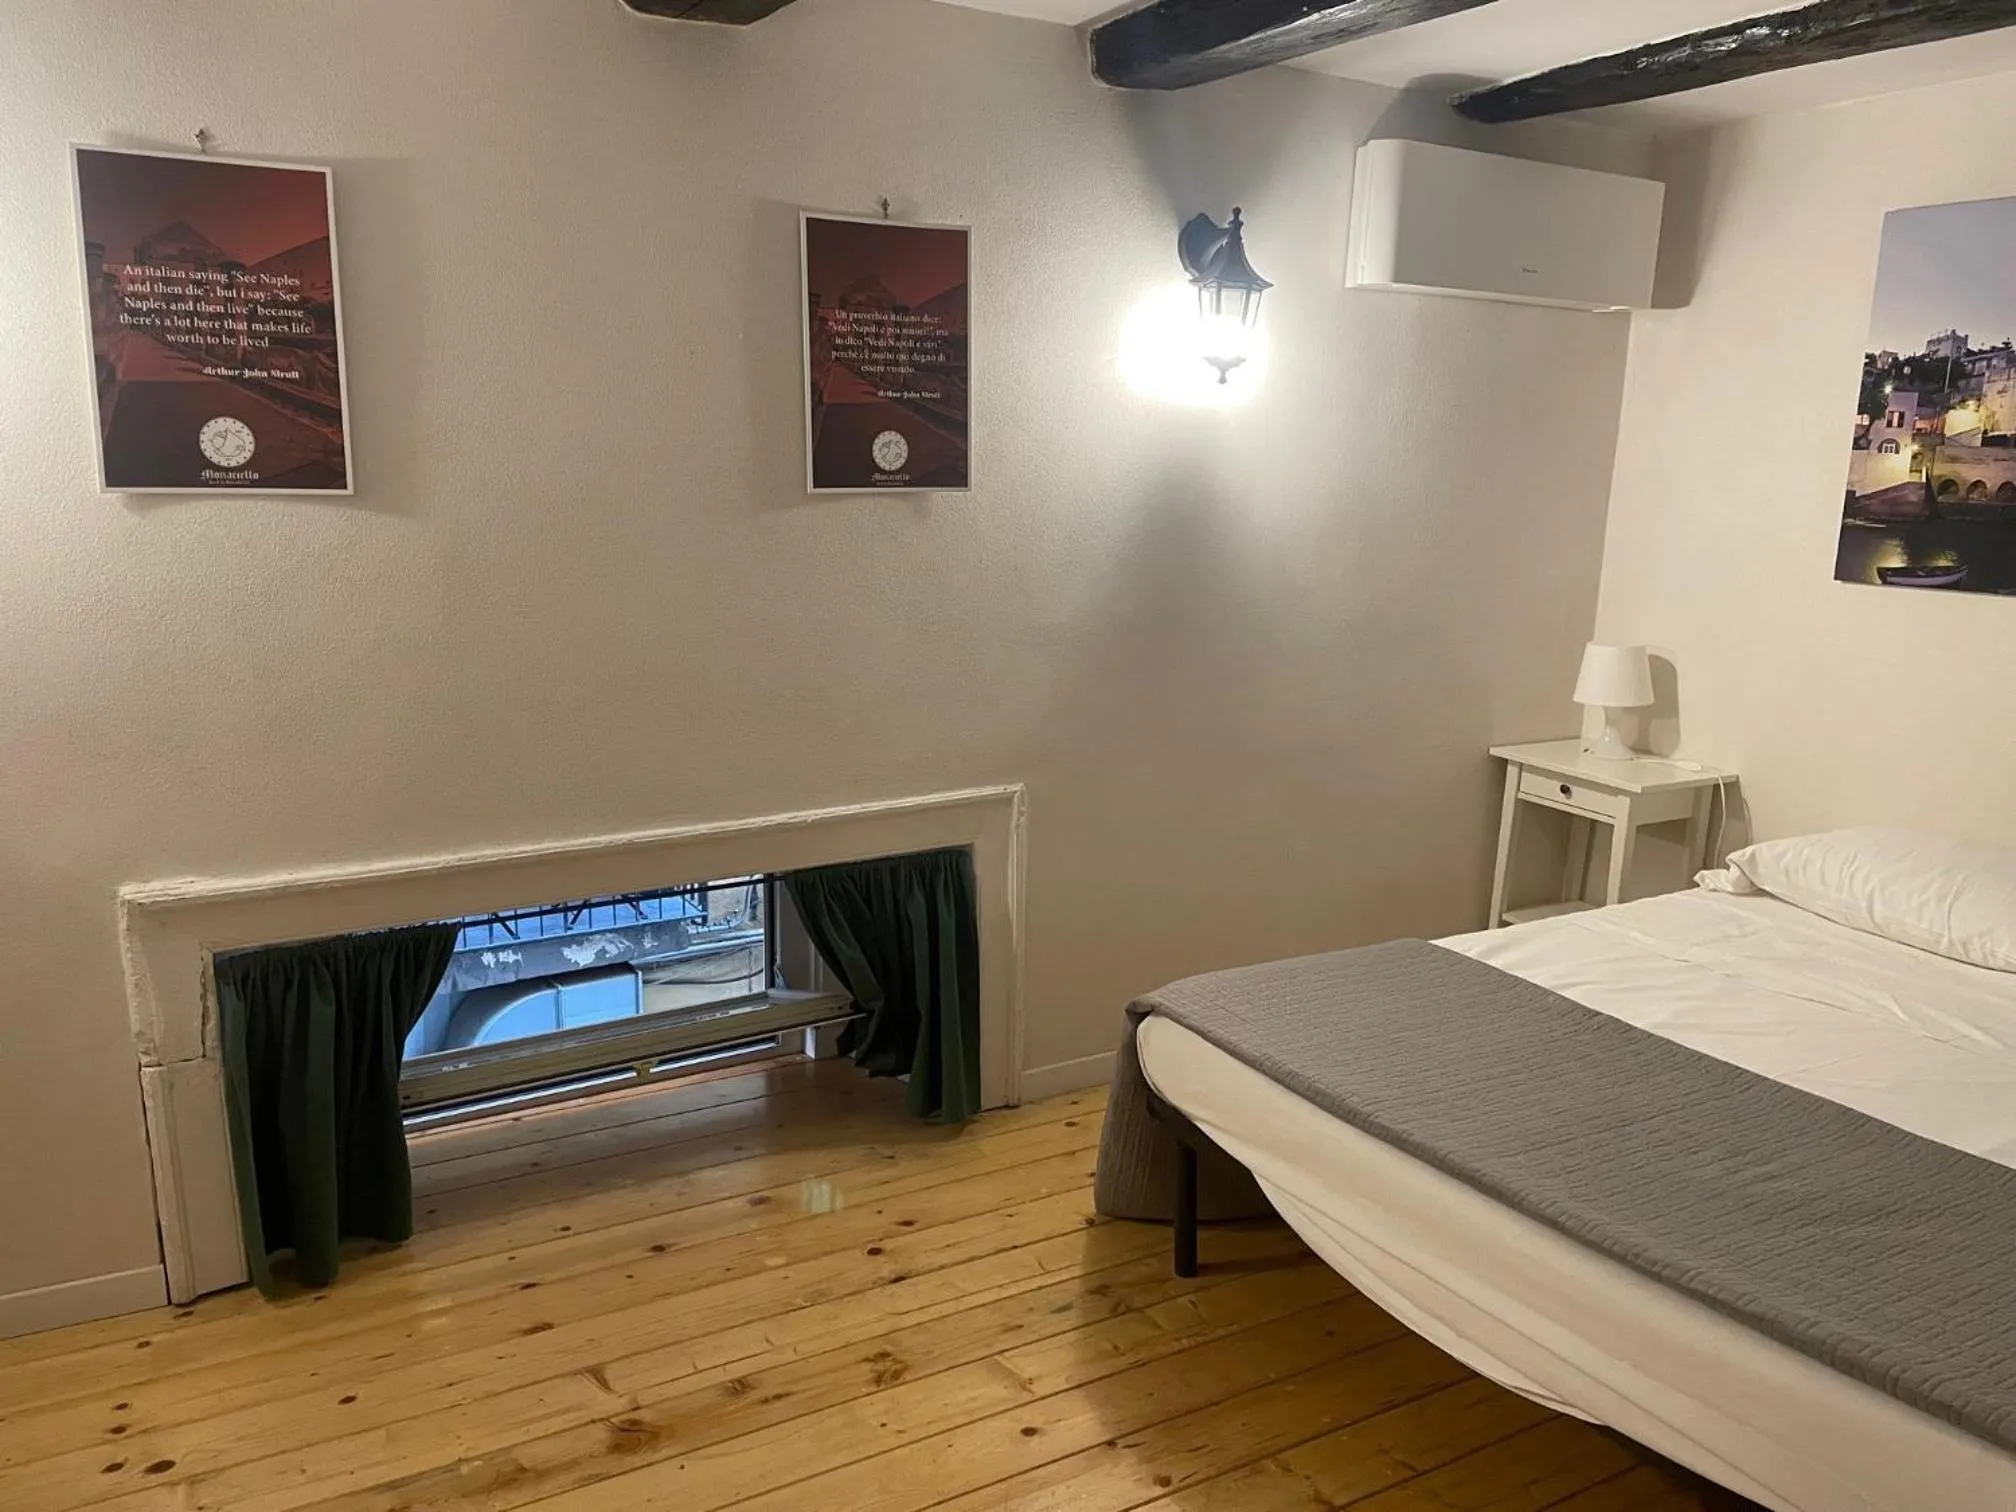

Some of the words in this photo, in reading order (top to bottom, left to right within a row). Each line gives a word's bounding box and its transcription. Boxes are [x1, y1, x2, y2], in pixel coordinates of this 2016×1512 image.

[123, 264, 141, 276] An
[145, 265, 185, 278] italian
[189, 270, 228, 283] saying
[260, 273, 301, 286] Naples
[127, 281, 150, 292] and
[154, 282, 182, 295] then
[216, 286, 237, 298] but
[124, 297, 167, 312] Naples
[170, 300, 193, 312] and
[196, 301, 224, 313] then
[257, 305, 304, 318] because
[120, 313, 160, 326] there's
[173, 314, 191, 328] lot
[194, 315, 221, 329] here
[224, 317, 248, 330] that
[251, 318, 289, 332] makes
[292, 320, 311, 334] life
[166, 332, 203, 344] worth
[222, 334, 237, 345] be
[240, 335, 269, 348] lived
